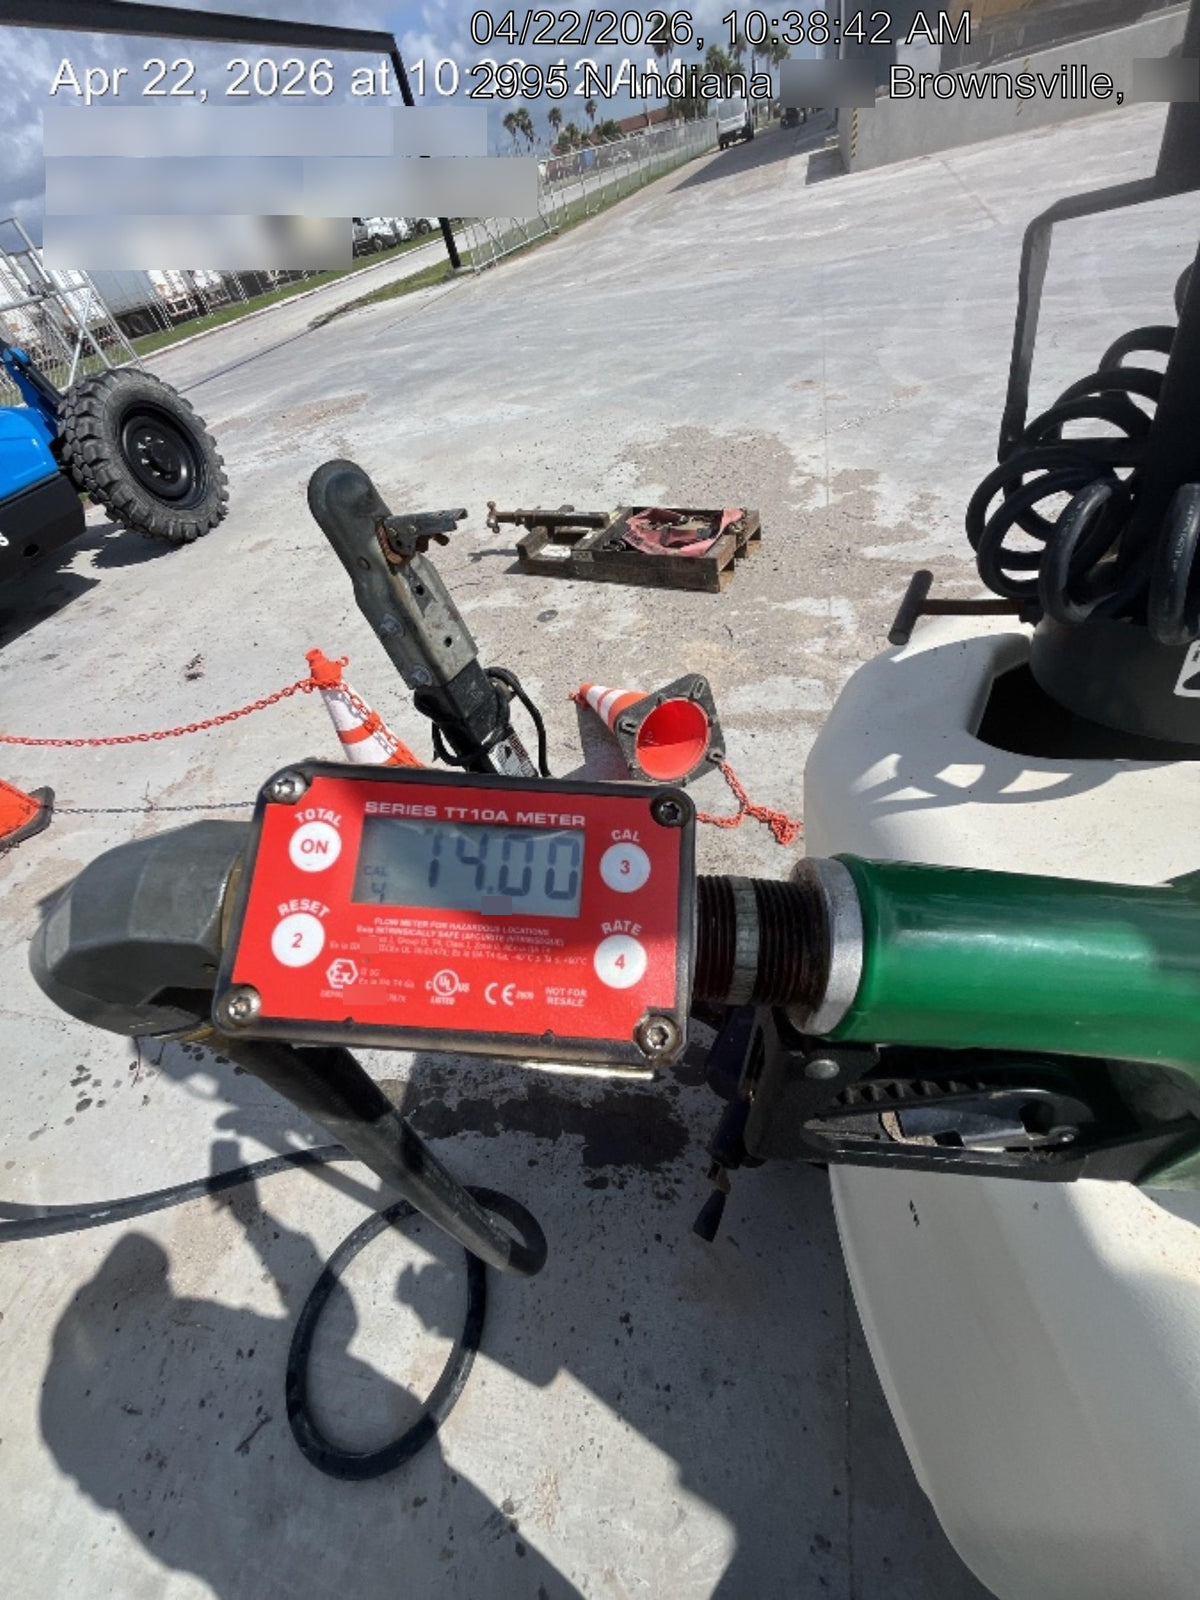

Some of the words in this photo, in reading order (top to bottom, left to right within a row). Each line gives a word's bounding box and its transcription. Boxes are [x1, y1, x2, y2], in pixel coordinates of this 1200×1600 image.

[294, 807, 343, 828] TOTAL
[365, 801, 437, 817] SERIES
[444, 806, 509, 823] TT10A
[516, 812, 586, 827] METER
[611, 828, 641, 843] CAL
[300, 838, 329, 855] ON
[620, 859, 631, 875] 3
[278, 898, 331, 919] RESET
[601, 919, 642, 936] RATE
[291, 932, 304, 949] 2
[614, 953, 626, 969] 4
[484, 982, 516, 1007] CE
[545, 986, 565, 997] NOT
[567, 988, 587, 998] FOR
[547, 996, 585, 1007] RESALE
